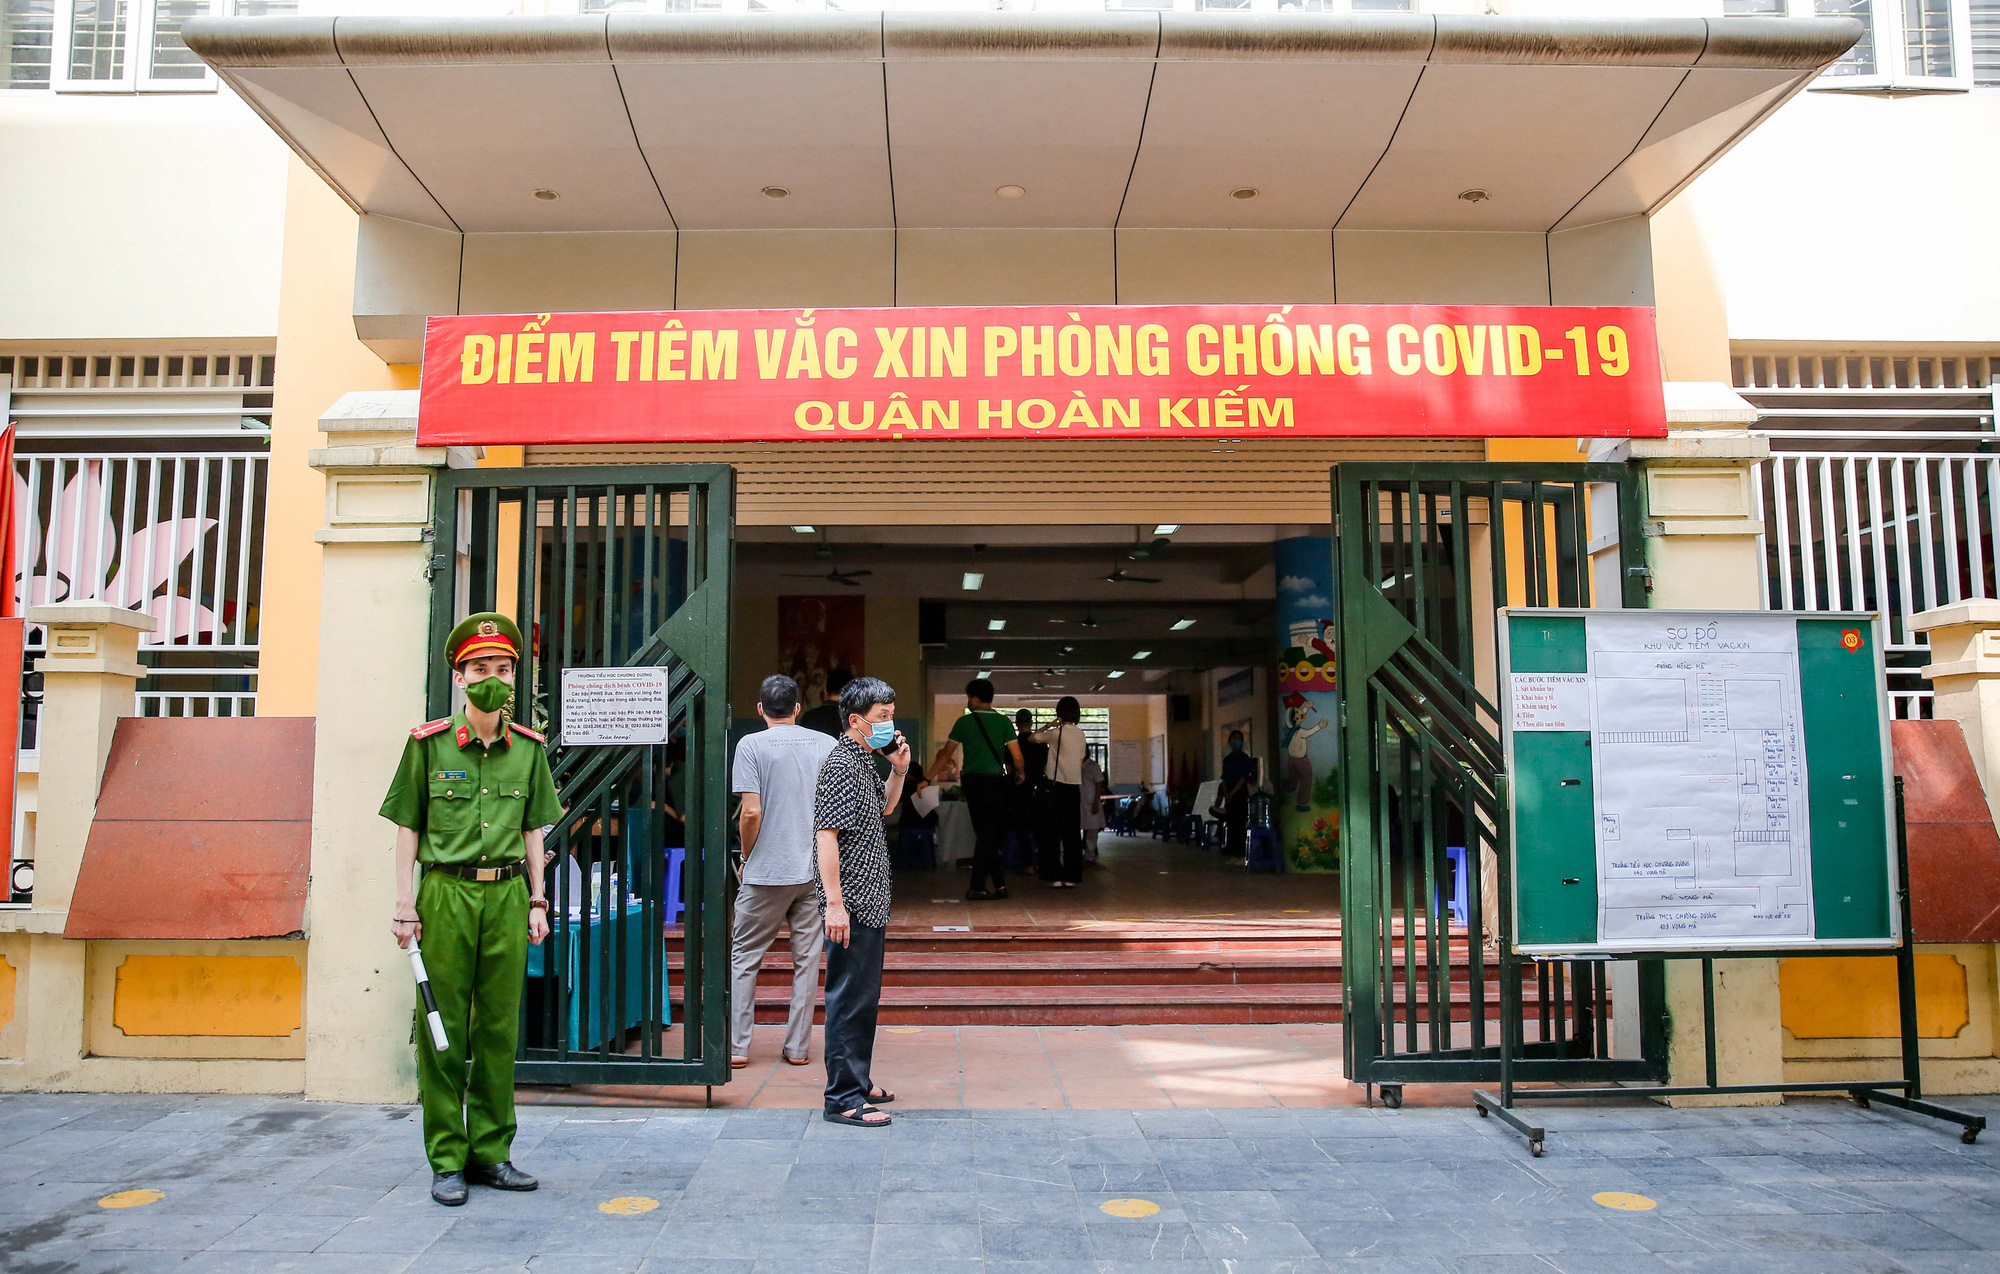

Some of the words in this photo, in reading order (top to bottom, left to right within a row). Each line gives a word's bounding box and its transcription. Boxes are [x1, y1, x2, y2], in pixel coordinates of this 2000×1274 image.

[460, 313, 596, 385] ĐIỂM
[611, 319, 740, 382] TIÊM
[755, 308, 859, 380] VẮC
[873, 327, 968, 378] XIN
[984, 312, 1170, 378] PHÒNG
[1186, 305, 1371, 377] CHỐNG
[1386, 324, 1631, 377] COVID-19
[794, 391, 959, 440] QUẬN
[978, 390, 1141, 430] HOÀN
[1159, 385, 1295, 428] KIẾM
[1667, 627, 1688, 640] SƠ
[1695, 621, 1719, 640] ĐỒ
[1846, 636, 1856, 644] 03
[1688, 641, 1710, 650] TIÊM
[1528, 675, 1545, 683] BƯỚC
[1546, 675, 1561, 683] TIÊM
[587, 682, 603, 690] chống
[604, 682, 617, 690] dịch
[617, 682, 631, 690] bệnh
